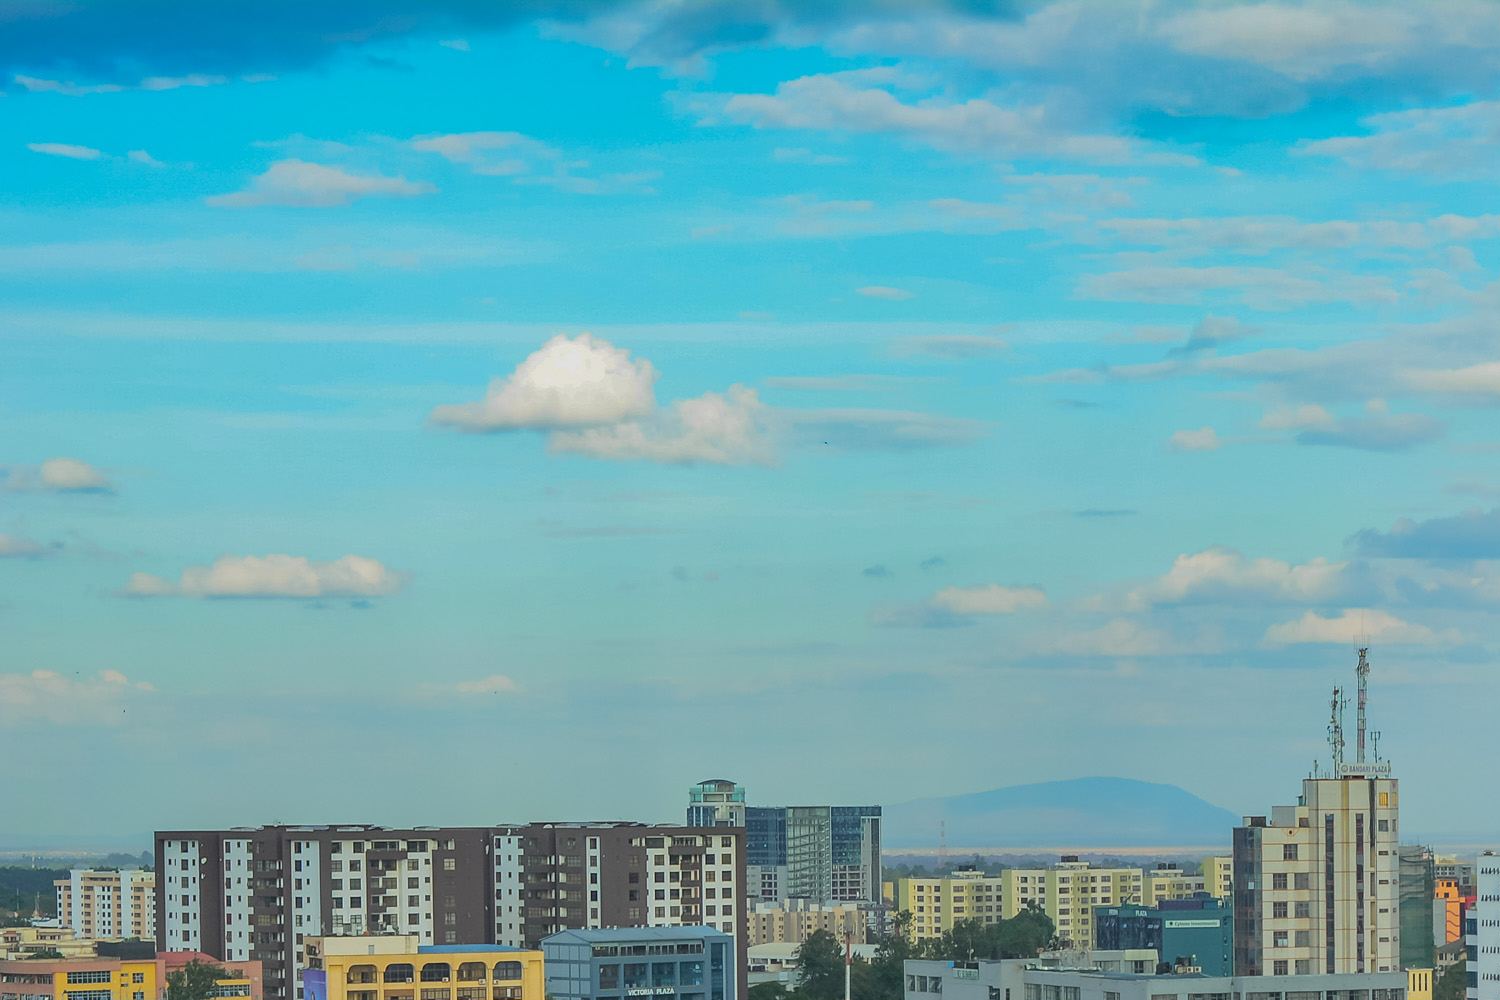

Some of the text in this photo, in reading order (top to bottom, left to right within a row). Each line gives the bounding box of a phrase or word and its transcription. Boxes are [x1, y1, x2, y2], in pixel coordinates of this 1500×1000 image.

[1372, 765, 1388, 773] PLAZA
[628, 987, 675, 996] VICTORIA PLAZA
